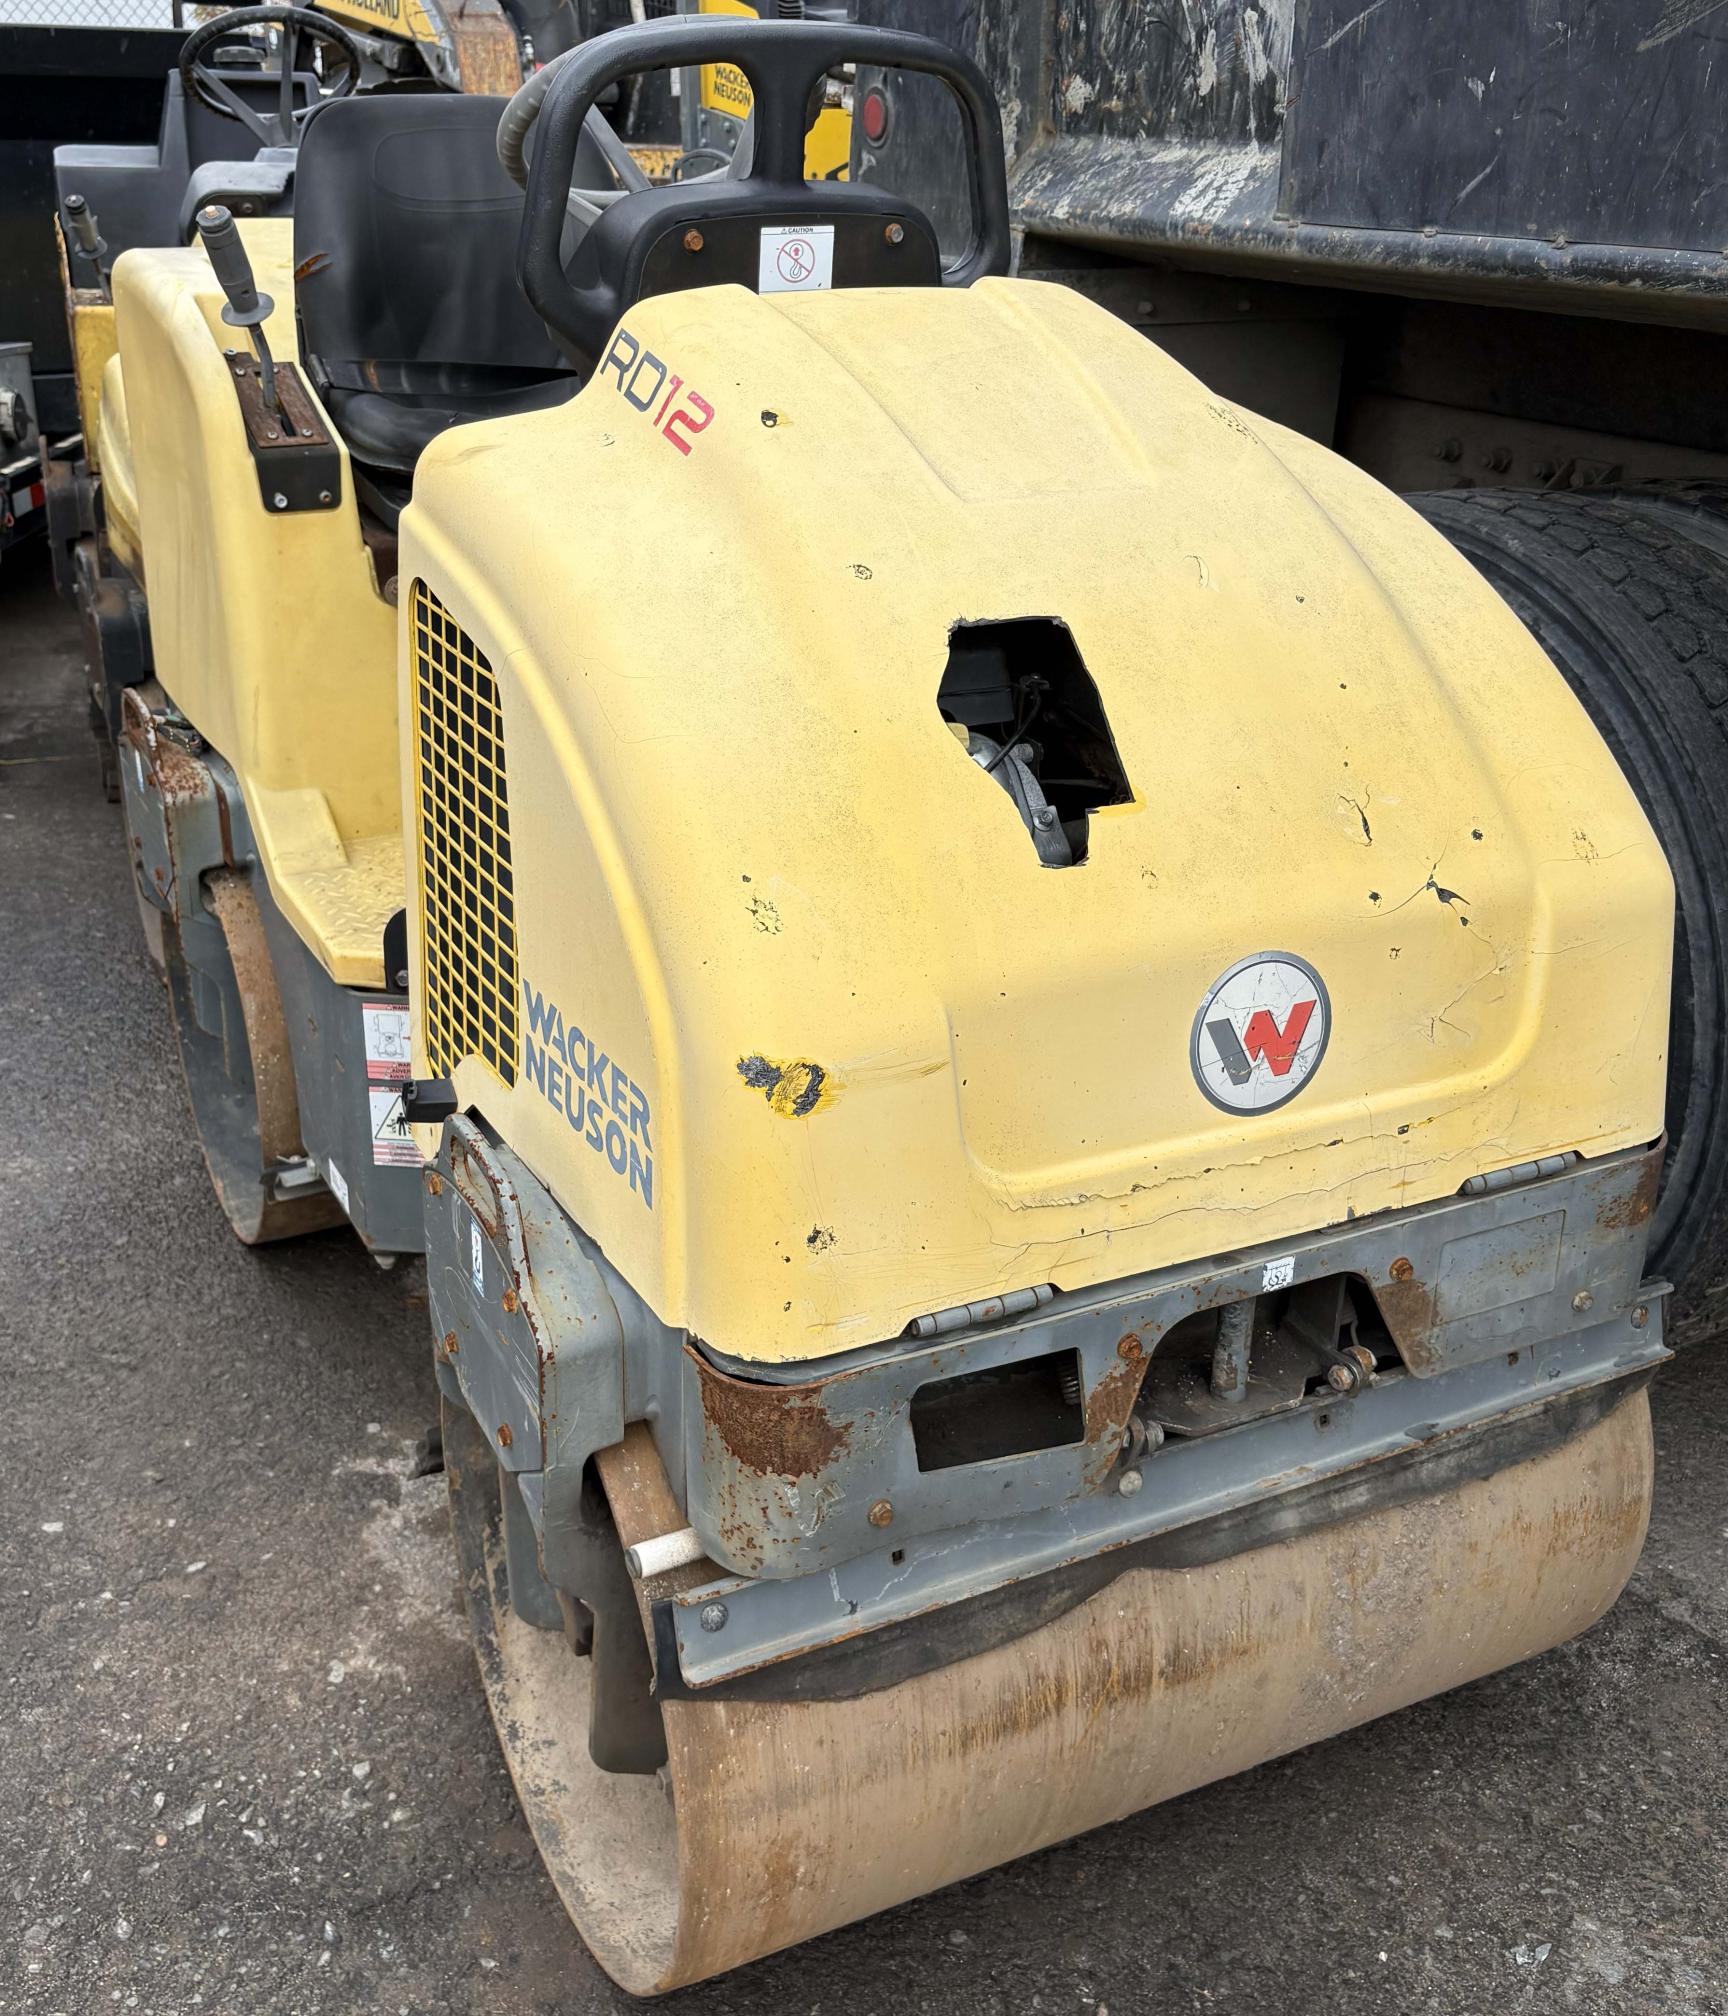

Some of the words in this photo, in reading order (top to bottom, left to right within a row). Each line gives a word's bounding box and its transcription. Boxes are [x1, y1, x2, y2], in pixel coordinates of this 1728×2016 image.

[714, 80, 751, 106] NEUSON
[600, 327, 715, 456] RD12
[523, 978, 653, 1153] WACKER
[526, 1032, 653, 1211] NEUSON
